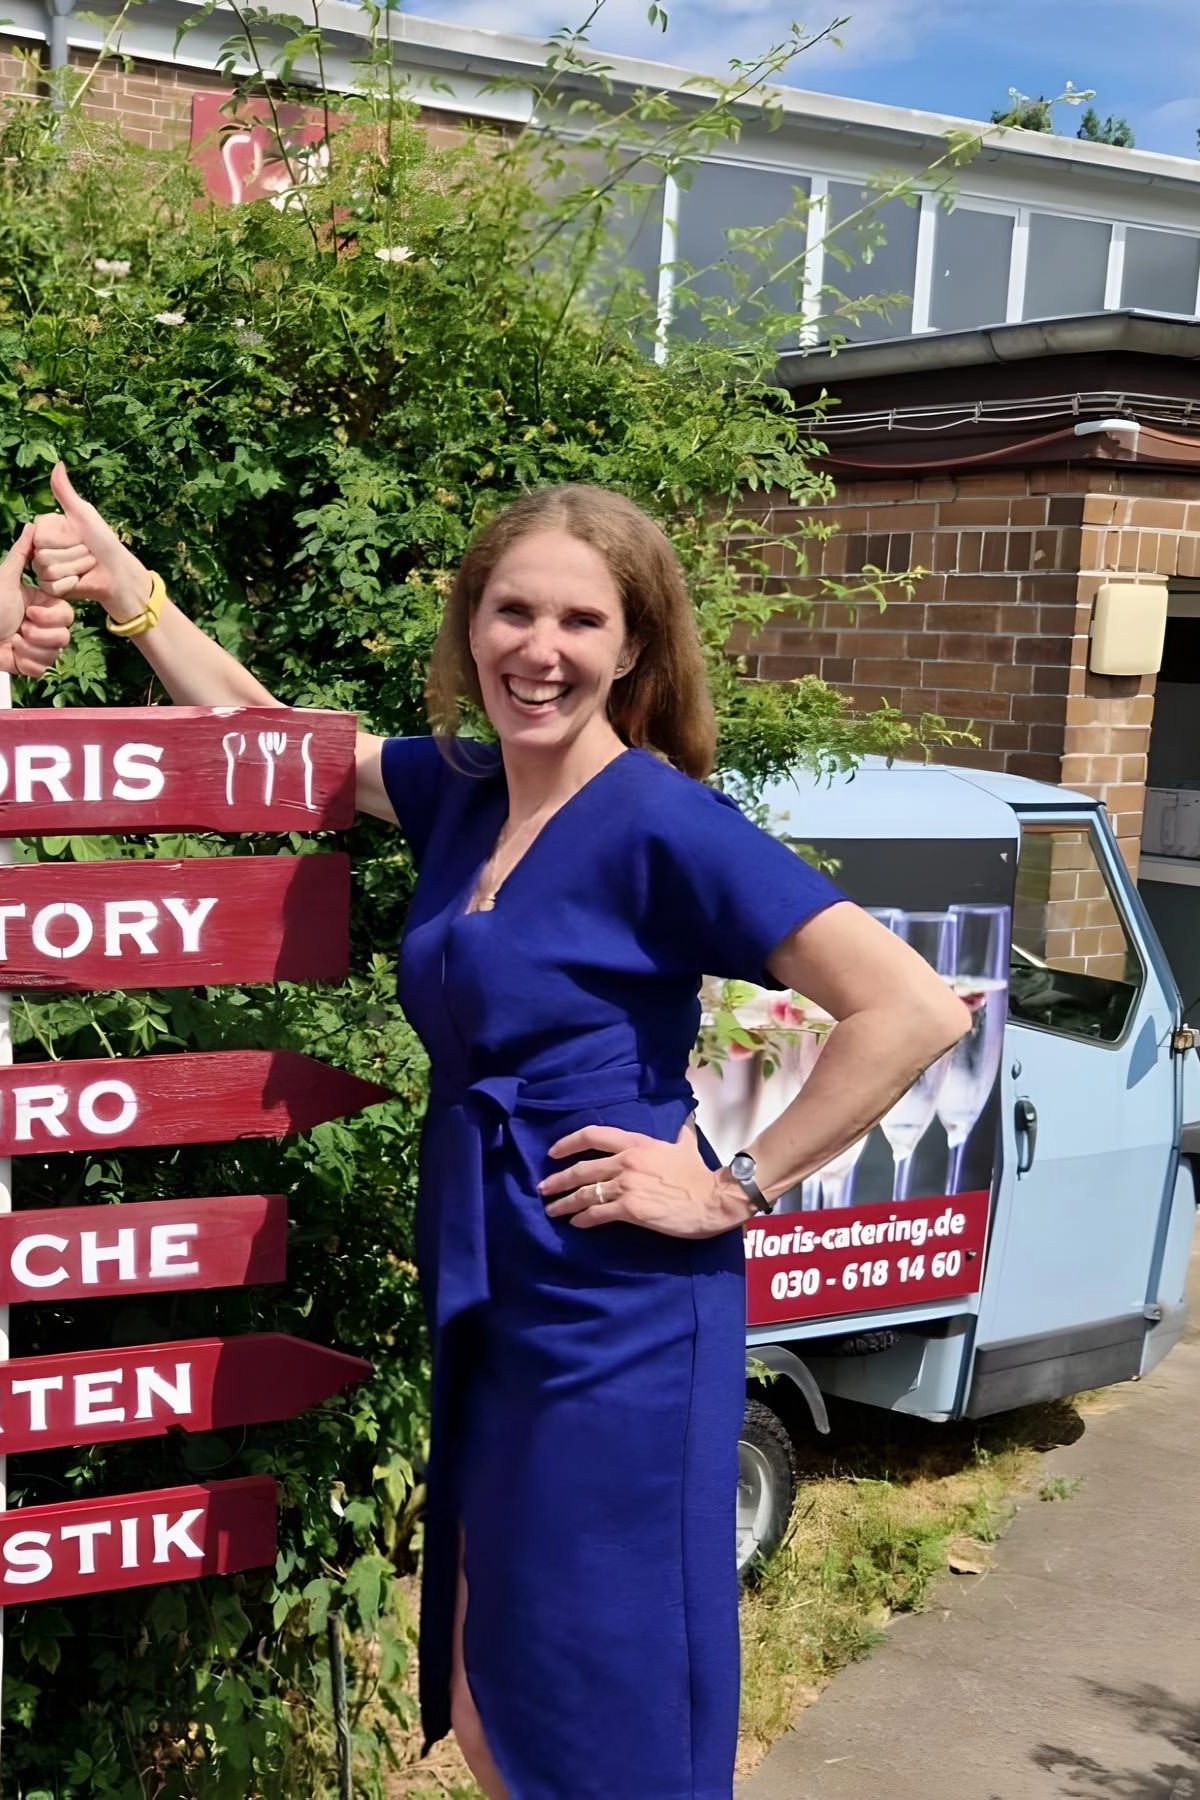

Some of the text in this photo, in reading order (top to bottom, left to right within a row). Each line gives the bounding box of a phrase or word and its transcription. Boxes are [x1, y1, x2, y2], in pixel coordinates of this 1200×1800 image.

[743, 1208, 966, 1259] floris-catering.de
[770, 1268, 820, 1300] 030
[842, 1260, 889, 1290] 618
[897, 1255, 925, 1282] 14
[931, 1250, 961, 1278] 60
